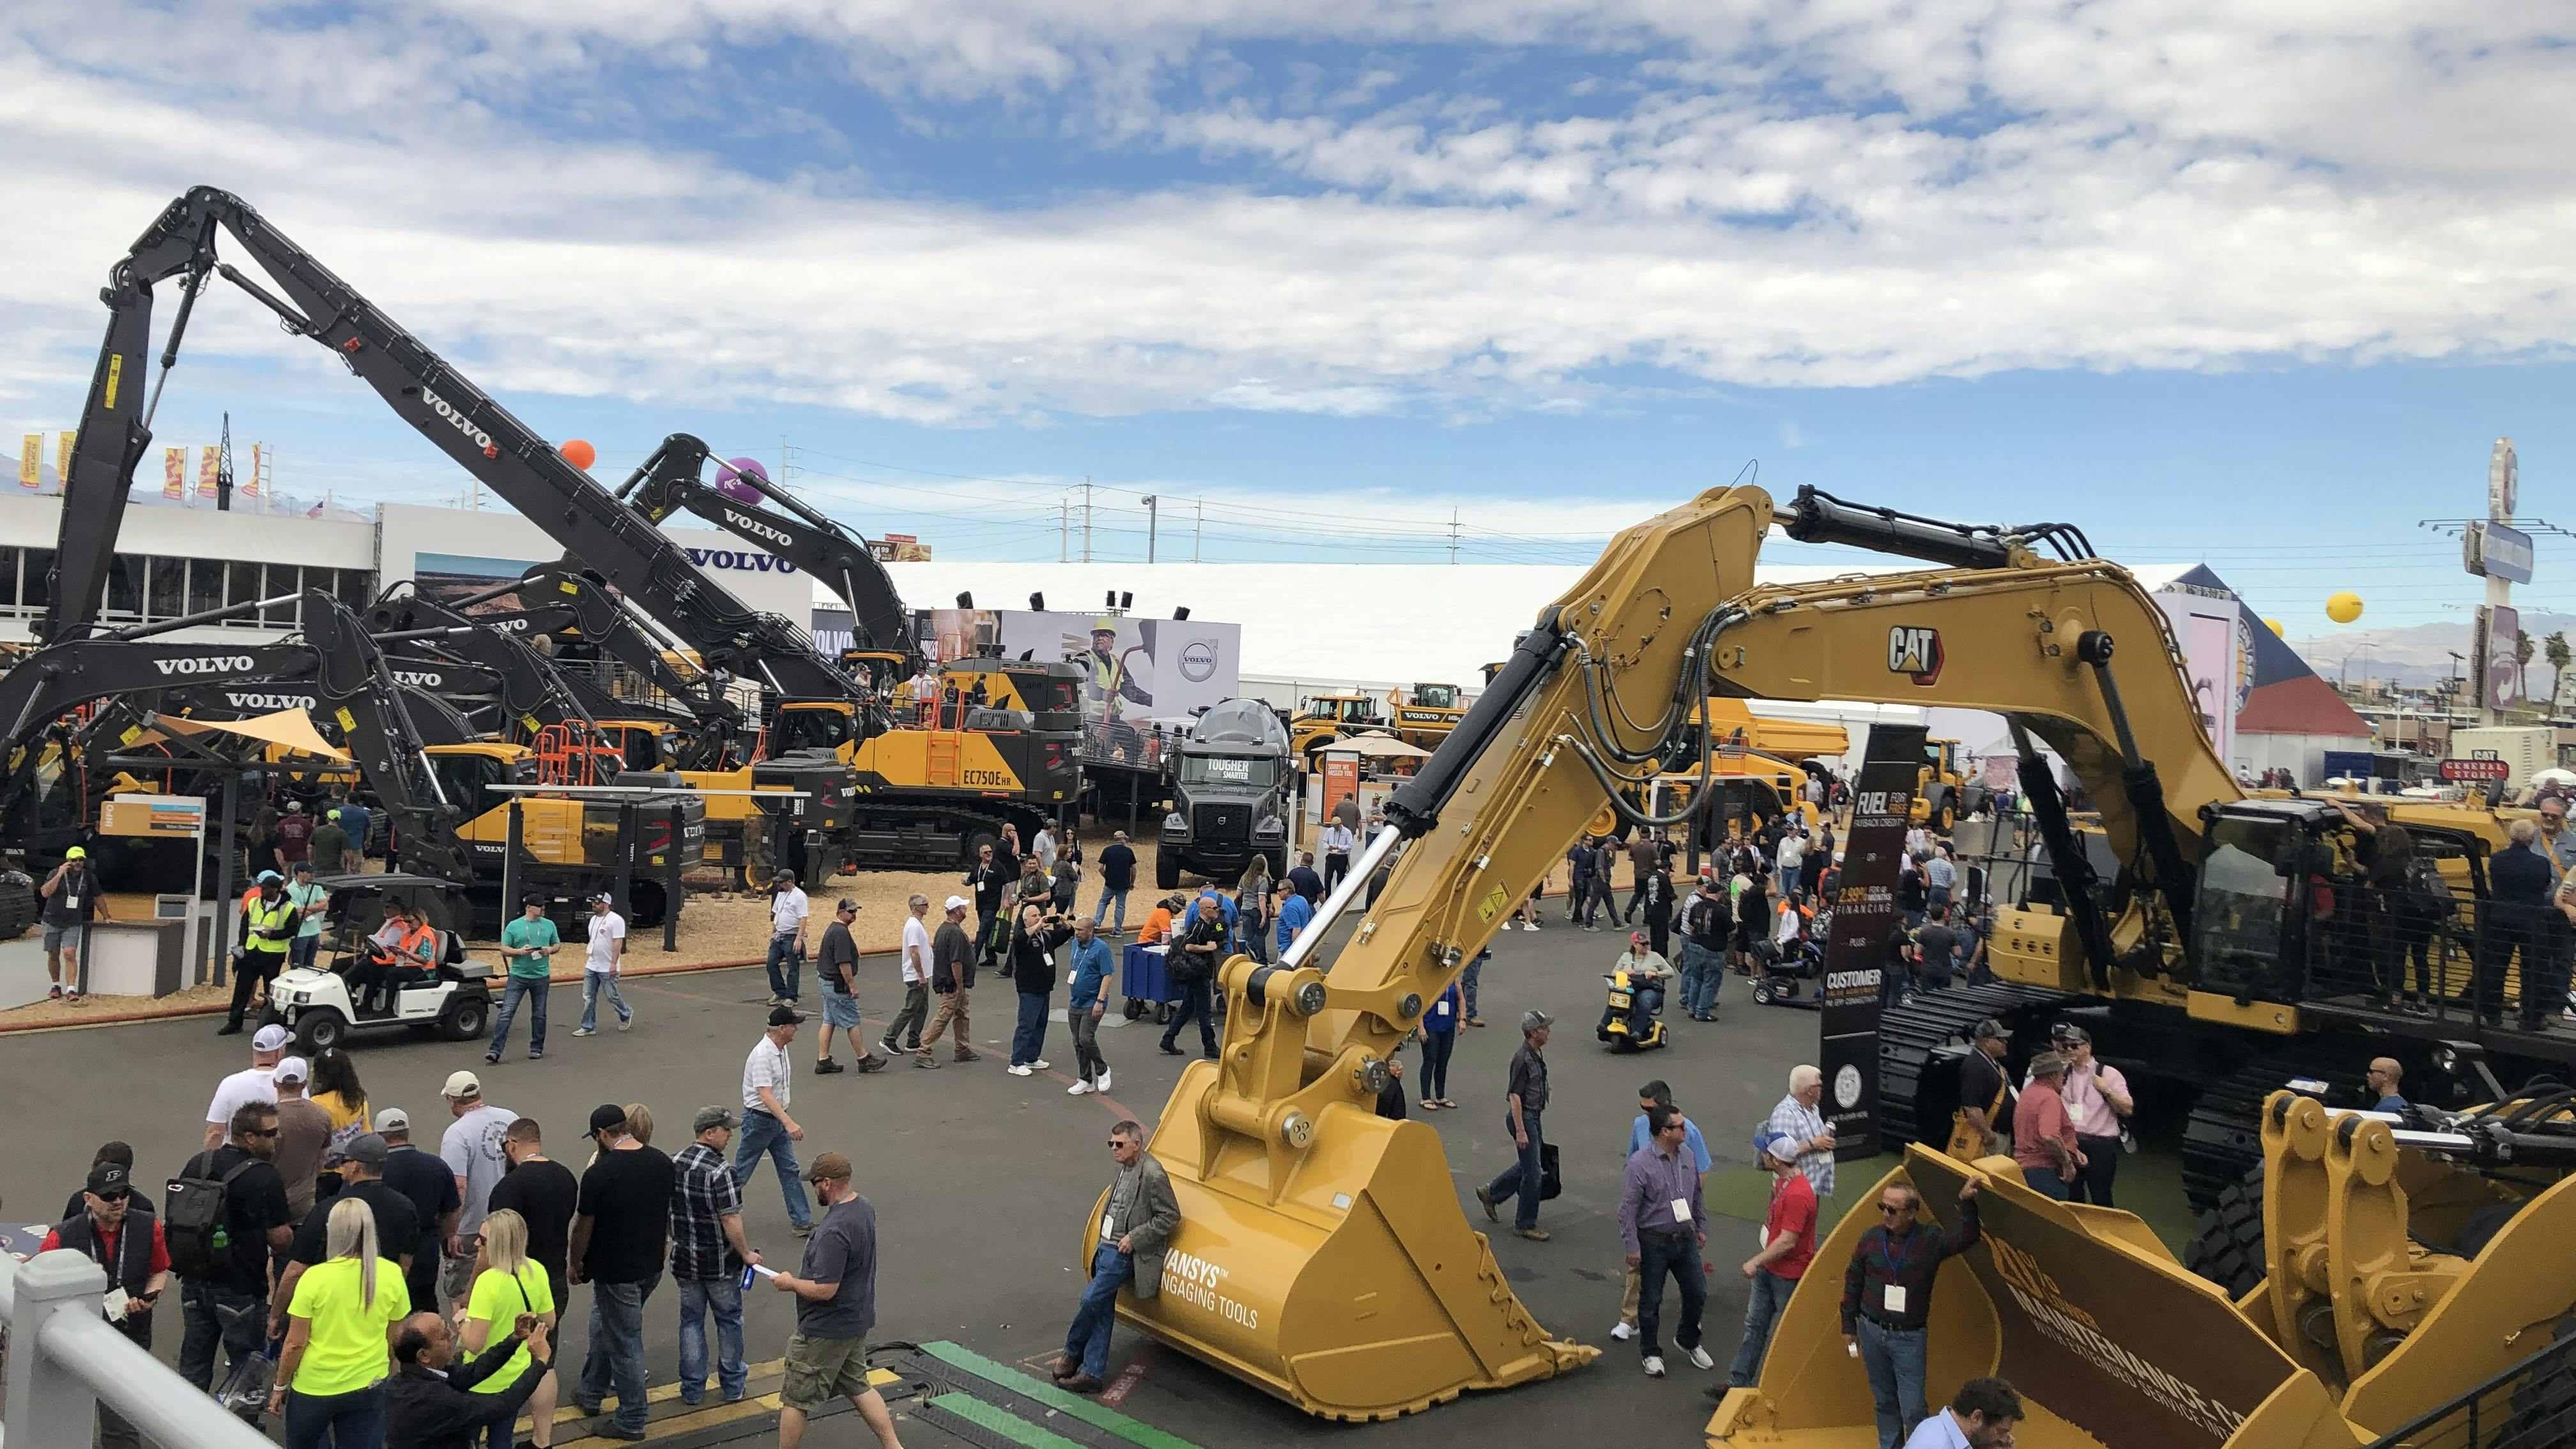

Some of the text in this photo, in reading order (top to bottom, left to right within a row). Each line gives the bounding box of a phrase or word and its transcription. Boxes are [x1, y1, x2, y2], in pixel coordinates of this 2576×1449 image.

[423, 385, 492, 448] VOLVO
[724, 508, 792, 546] VOLVO
[685, 548, 797, 574] VOLVO
[1889, 627, 1933, 671] CAT
[153, 656, 254, 675] VOLVO
[393, 671, 441, 686] LVO
[226, 693, 316, 710] VOLVO
[2473, 751, 2496, 760] CAT
[1208, 758, 1248, 772] TOUGHER
[2445, 761, 2504, 771] GENERAL
[1223, 771, 1248, 779] SMARTER
[2453, 770, 2495, 779] STORE
[1855, 792, 1907, 815] FUEL FOR
[1889, 803, 1907, 814] FREE
[105, 804, 114, 828] INFO
[475, 845, 505, 854] VOLV
[1866, 852, 1877, 862] OR
[1867, 893, 1893, 901] MONTHS
[1836, 903, 1892, 915] FINANCING
[1849, 937, 1867, 947] PLUS
[1827, 969, 1882, 990] CUSTOMER
[1161, 1271, 1258, 1330] NGAGING TOOLS
[2005, 1282, 2218, 1422] MAINTENANCE
[2066, 1337, 2138, 1388] EXTENDED
[2138, 1379, 2204, 1428] SERVICE
